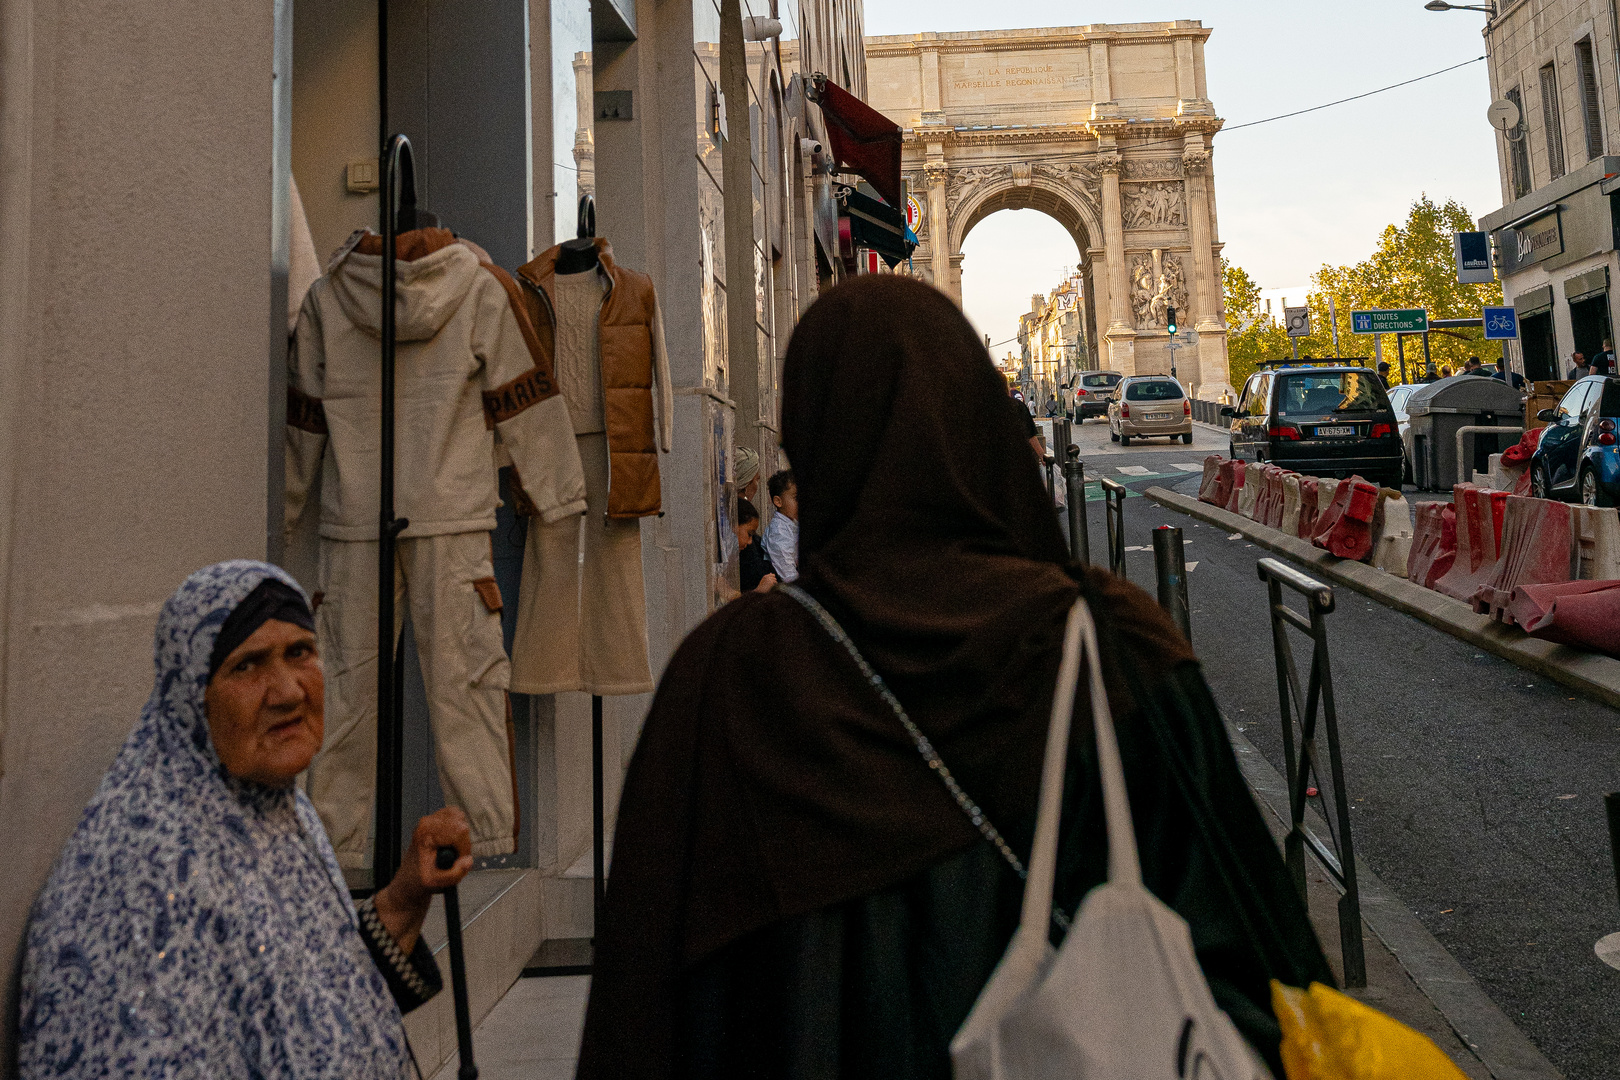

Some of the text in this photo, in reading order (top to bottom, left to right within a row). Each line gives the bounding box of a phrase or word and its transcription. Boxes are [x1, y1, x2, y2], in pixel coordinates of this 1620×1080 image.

[988, 68, 1000, 76] LA
[953, 80, 1002, 90] MARSEILLE
[1372, 313, 1399, 321] TOUTES
[1373, 321, 1414, 330] DIRECTIONS
[484, 370, 553, 418] PARIS
